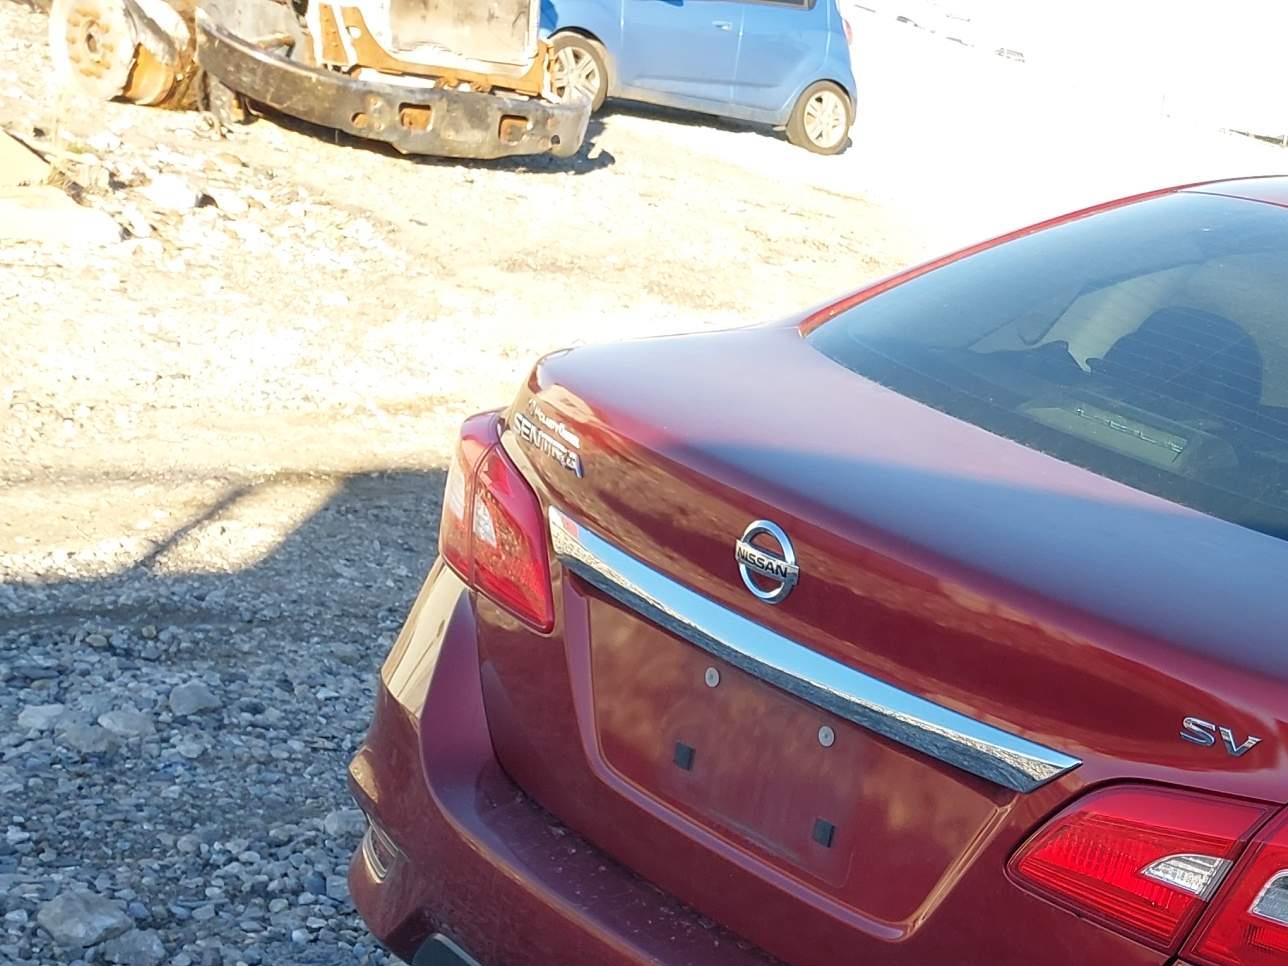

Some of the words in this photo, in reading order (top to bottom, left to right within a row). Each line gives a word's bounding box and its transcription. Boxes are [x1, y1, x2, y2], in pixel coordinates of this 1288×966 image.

[513, 412, 584, 478] SENTRA
[737, 546, 788, 578] NISSAN
[1180, 717, 1262, 757] SV
